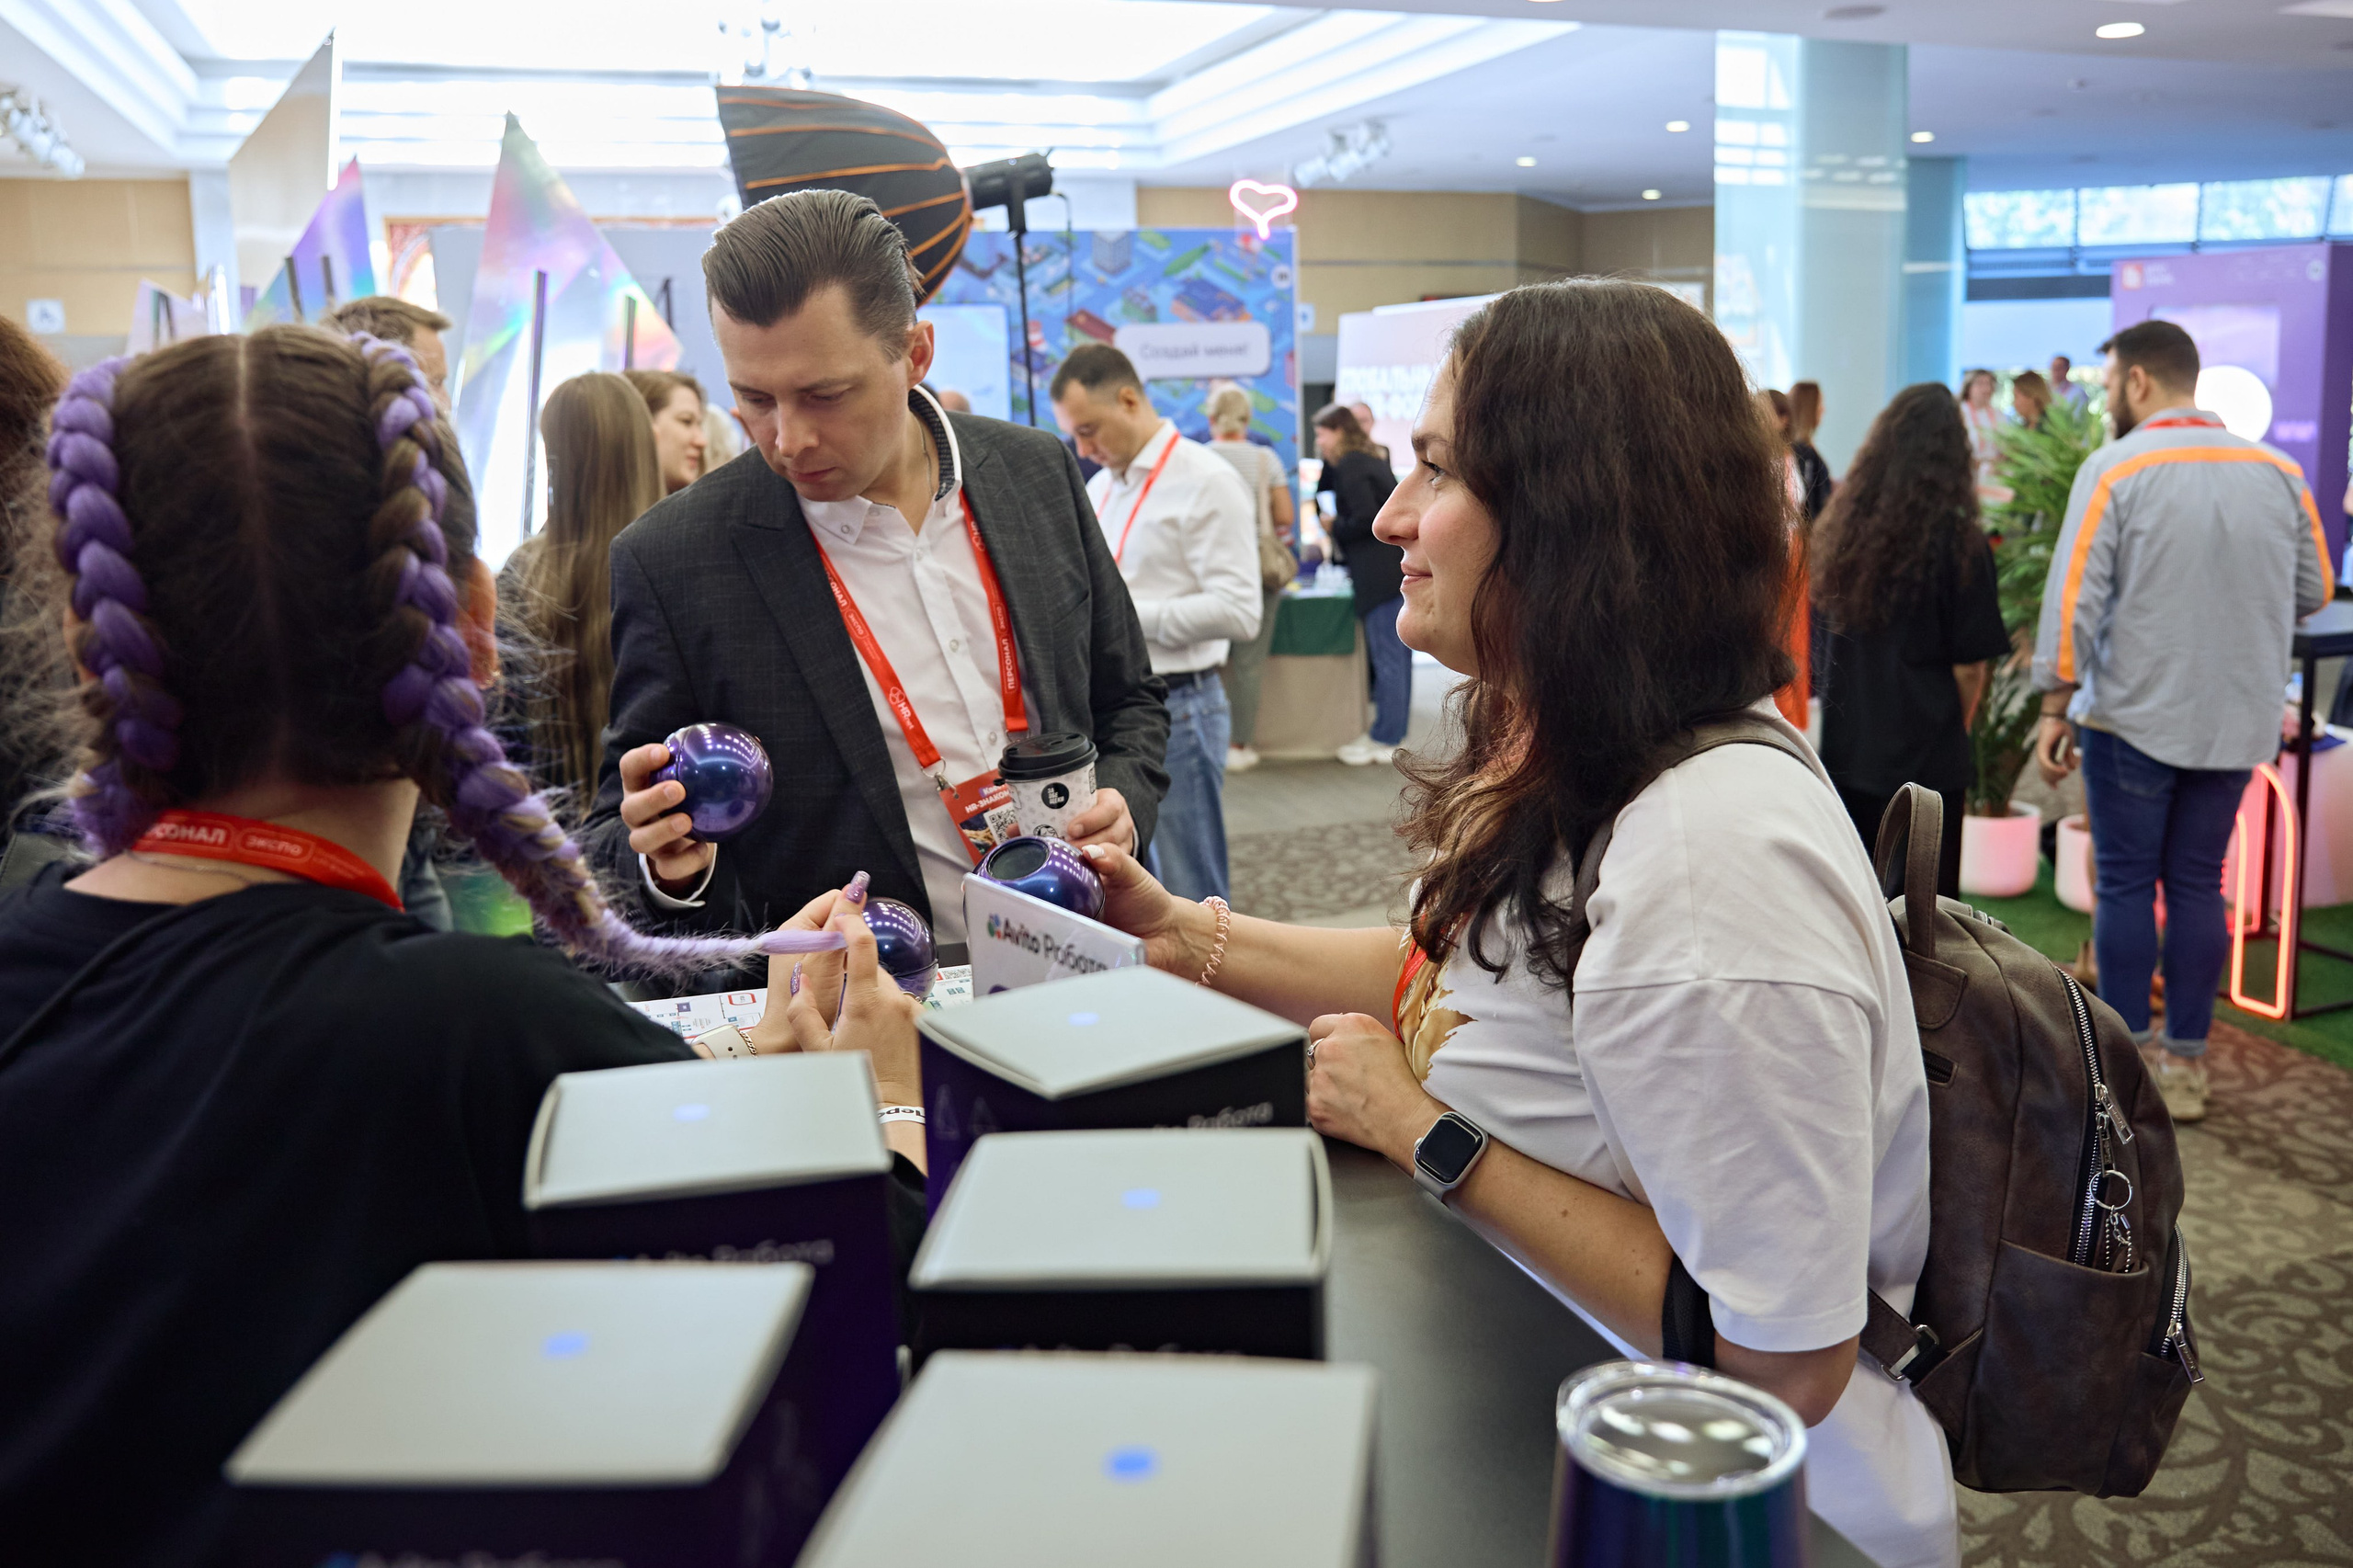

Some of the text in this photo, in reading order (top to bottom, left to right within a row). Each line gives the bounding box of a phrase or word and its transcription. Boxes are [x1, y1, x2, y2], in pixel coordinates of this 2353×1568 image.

[848, 612, 864, 635] ЭКСПО
[1002, 638, 1016, 689] ПЕРСОНАЛ
[964, 790, 1010, 813] HR-ЗНАКОМ
[152, 822, 303, 857] СОНАЛ ЭКСПО
[1003, 917, 1040, 954] Avito
